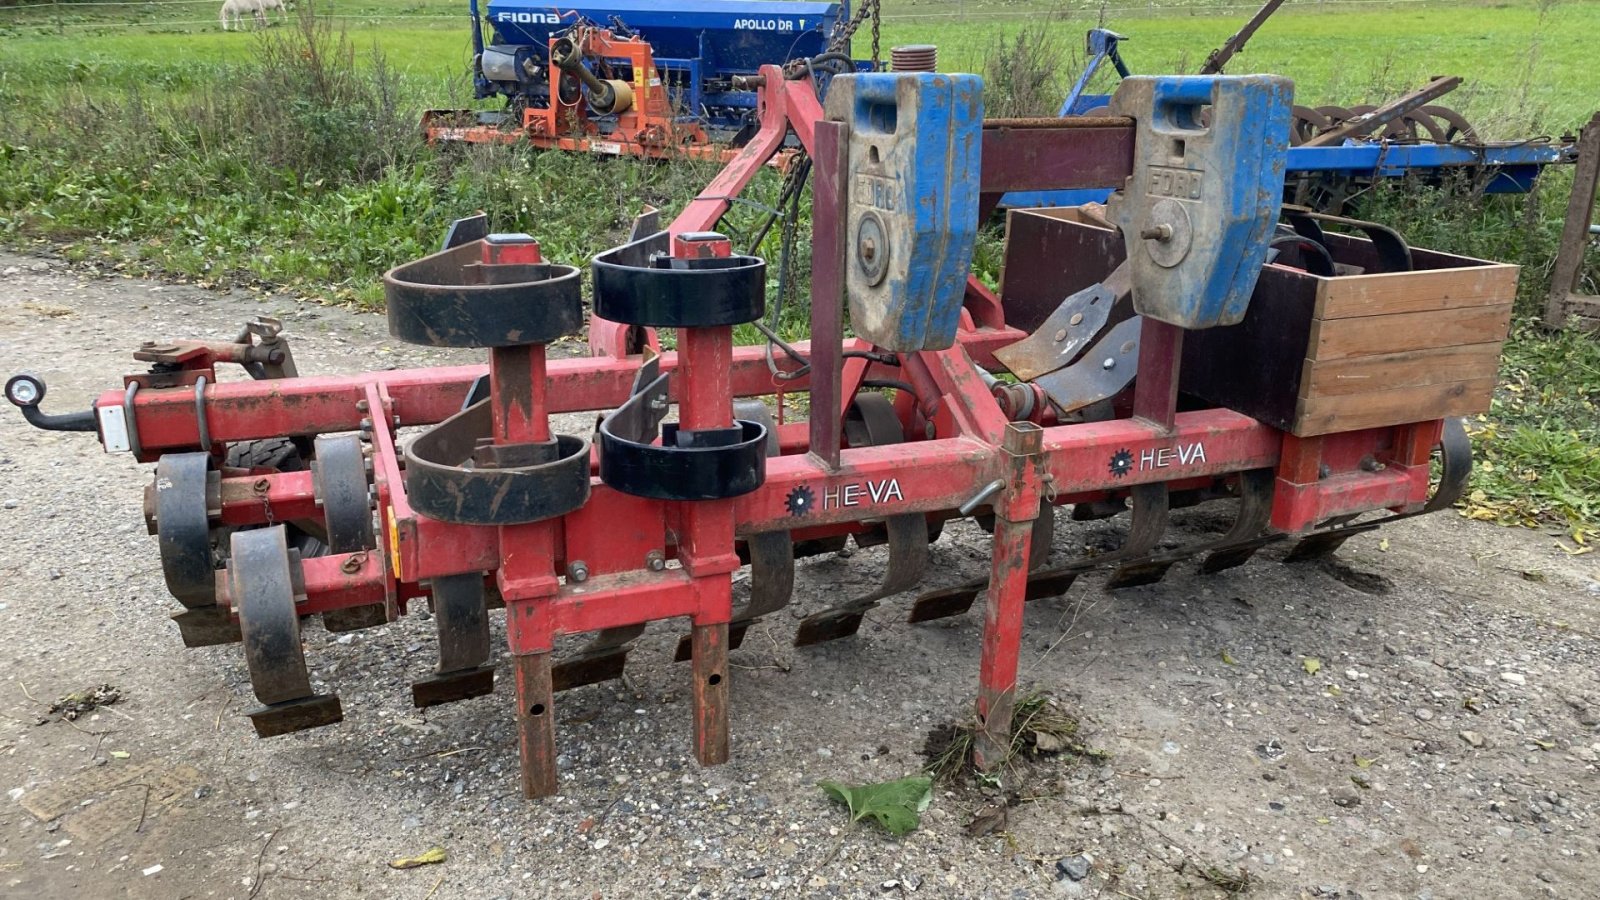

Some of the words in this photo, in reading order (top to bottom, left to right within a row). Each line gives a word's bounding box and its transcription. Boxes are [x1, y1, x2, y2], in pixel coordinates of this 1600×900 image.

[734, 19, 776, 30] APOLLO
[778, 20, 793, 31] DR
[1147, 169, 1201, 200] FORD
[1140, 442, 1206, 471] HE-VA
[824, 478, 904, 510] HE-VA
